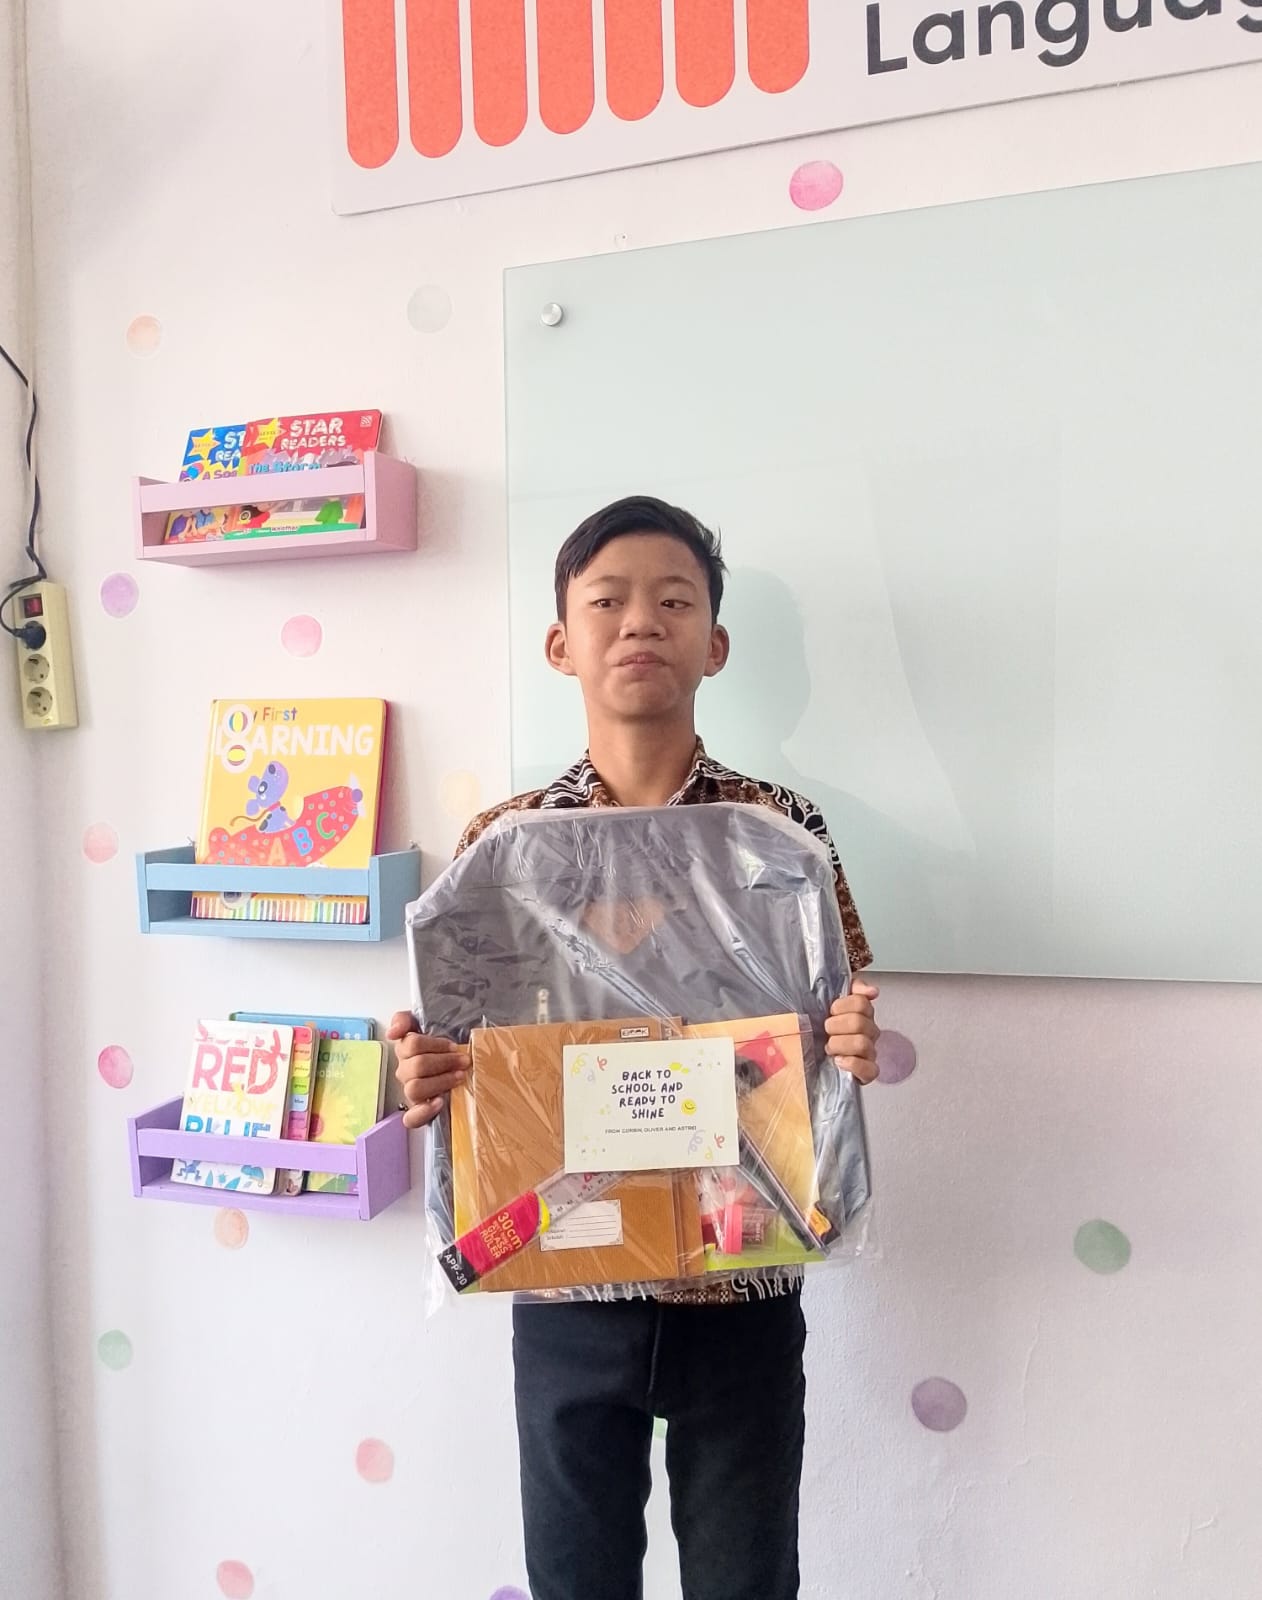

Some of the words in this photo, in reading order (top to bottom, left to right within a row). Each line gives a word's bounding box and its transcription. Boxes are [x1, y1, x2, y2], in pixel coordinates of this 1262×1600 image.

[866, 0, 1262, 75] Langu
[280, 434, 346, 450] READERS
[290, 417, 343, 438] STAR
[263, 707, 298, 721] First
[215, 723, 375, 757] LARNING
[292, 826, 313, 856] B
[316, 812, 336, 839] C
[192, 1043, 279, 1095] RED
[622, 1070, 652, 1081] BACK
[656, 1069, 672, 1079] TO
[611, 1083, 657, 1095] SCHOOL
[661, 1081, 683, 1093] AND
[619, 1095, 656, 1108] READY
[660, 1094, 676, 1105] TO
[631, 1108, 665, 1120] SHINE
[479, 1230, 502, 1259] RULER
[486, 1226, 509, 1255] GLASS
[497, 1212, 523, 1250] 30cm
[443, 1252, 468, 1286] APP-30
